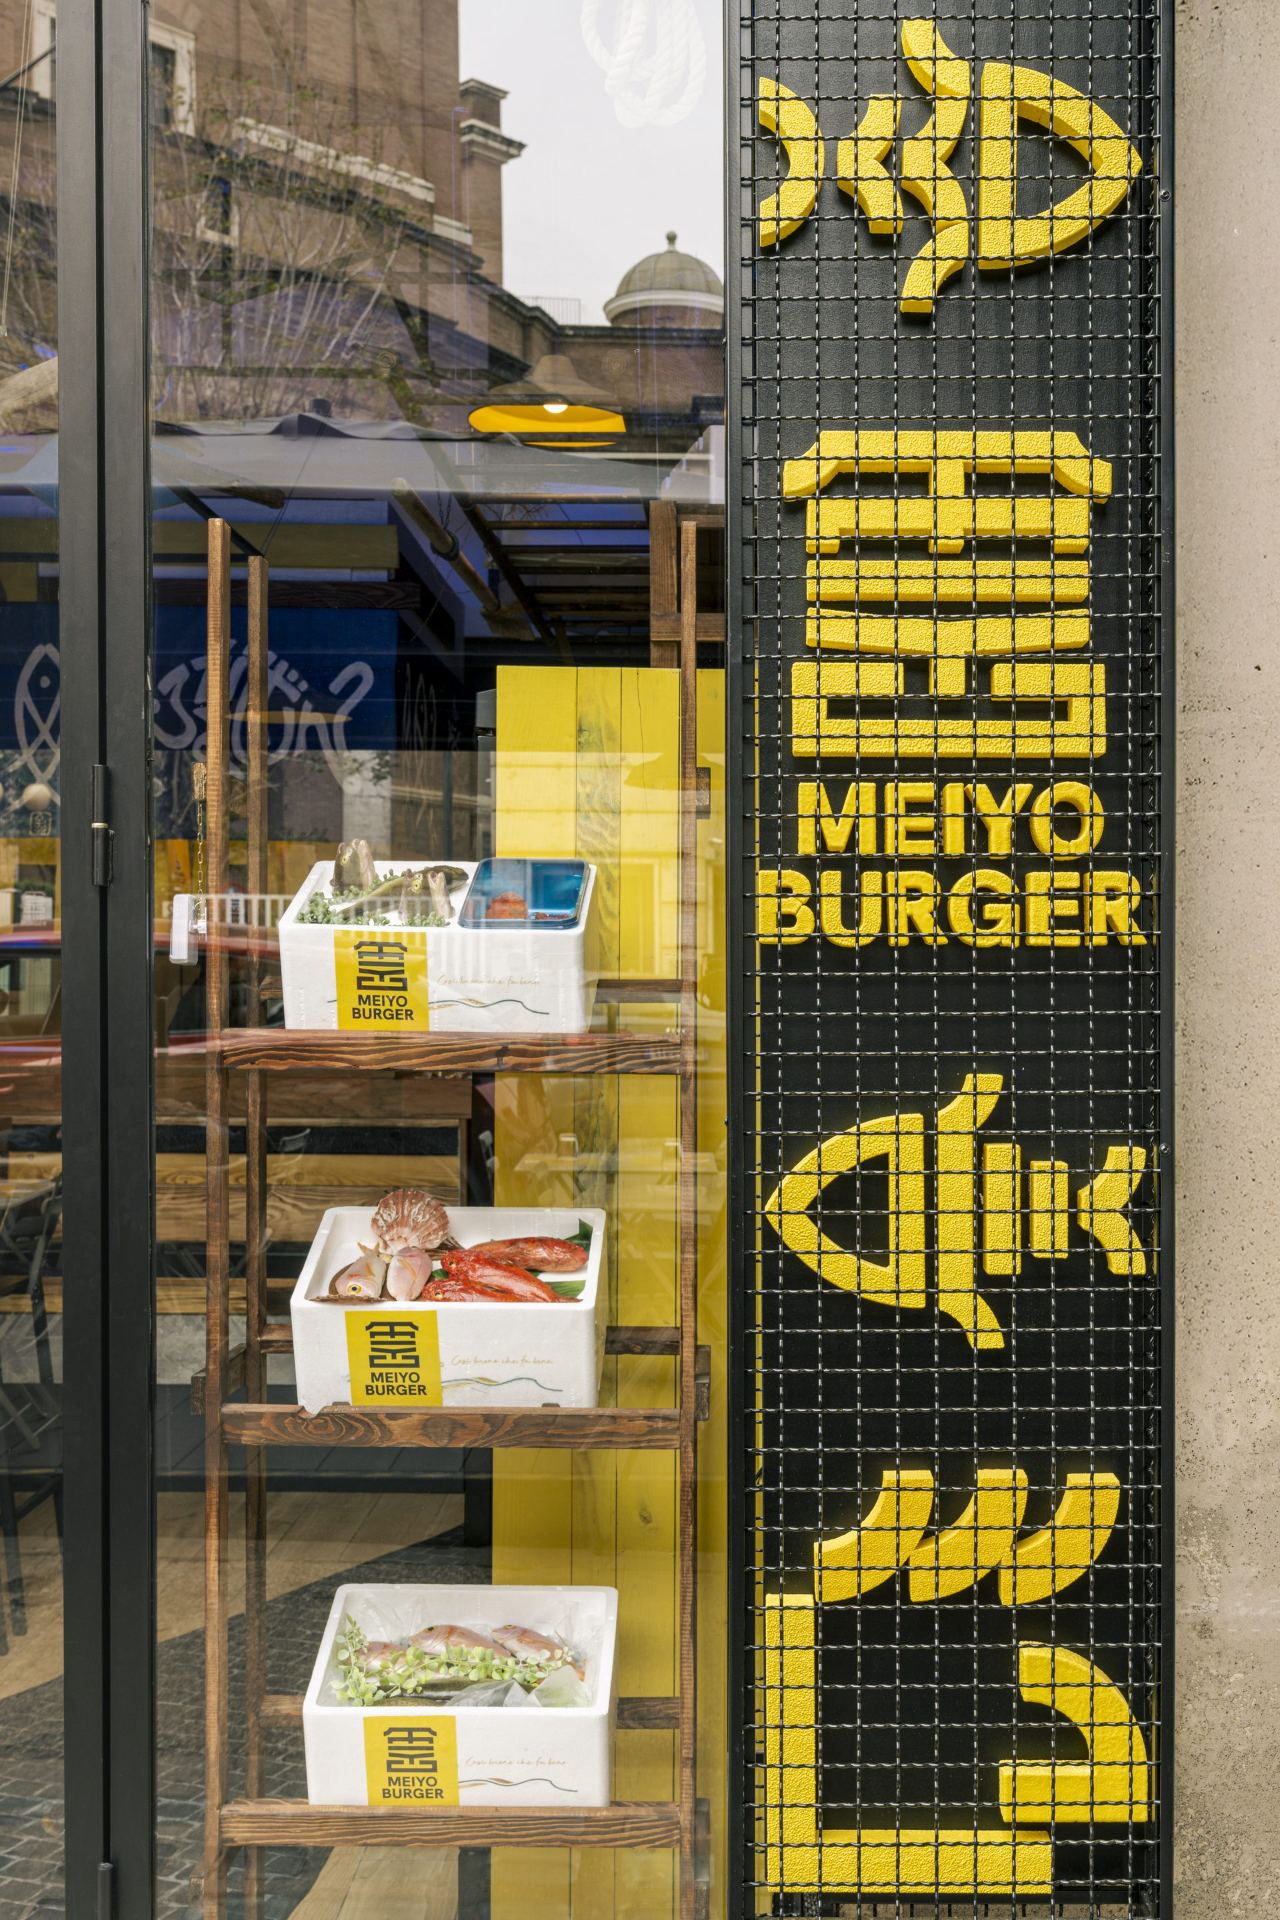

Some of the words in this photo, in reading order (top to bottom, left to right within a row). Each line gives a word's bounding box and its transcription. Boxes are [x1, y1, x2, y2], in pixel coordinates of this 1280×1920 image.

[797, 781, 1105, 861] MEIYO
[758, 869, 1147, 949] BURGER
[358, 994, 408, 1008] MEIYO
[352, 1007, 414, 1021] BURGER
[370, 1371, 421, 1384] MEIYO
[365, 1384, 428, 1396] BURGER
[387, 1776, 438, 1788] MEIYO
[382, 1788, 444, 1799] BURGER
